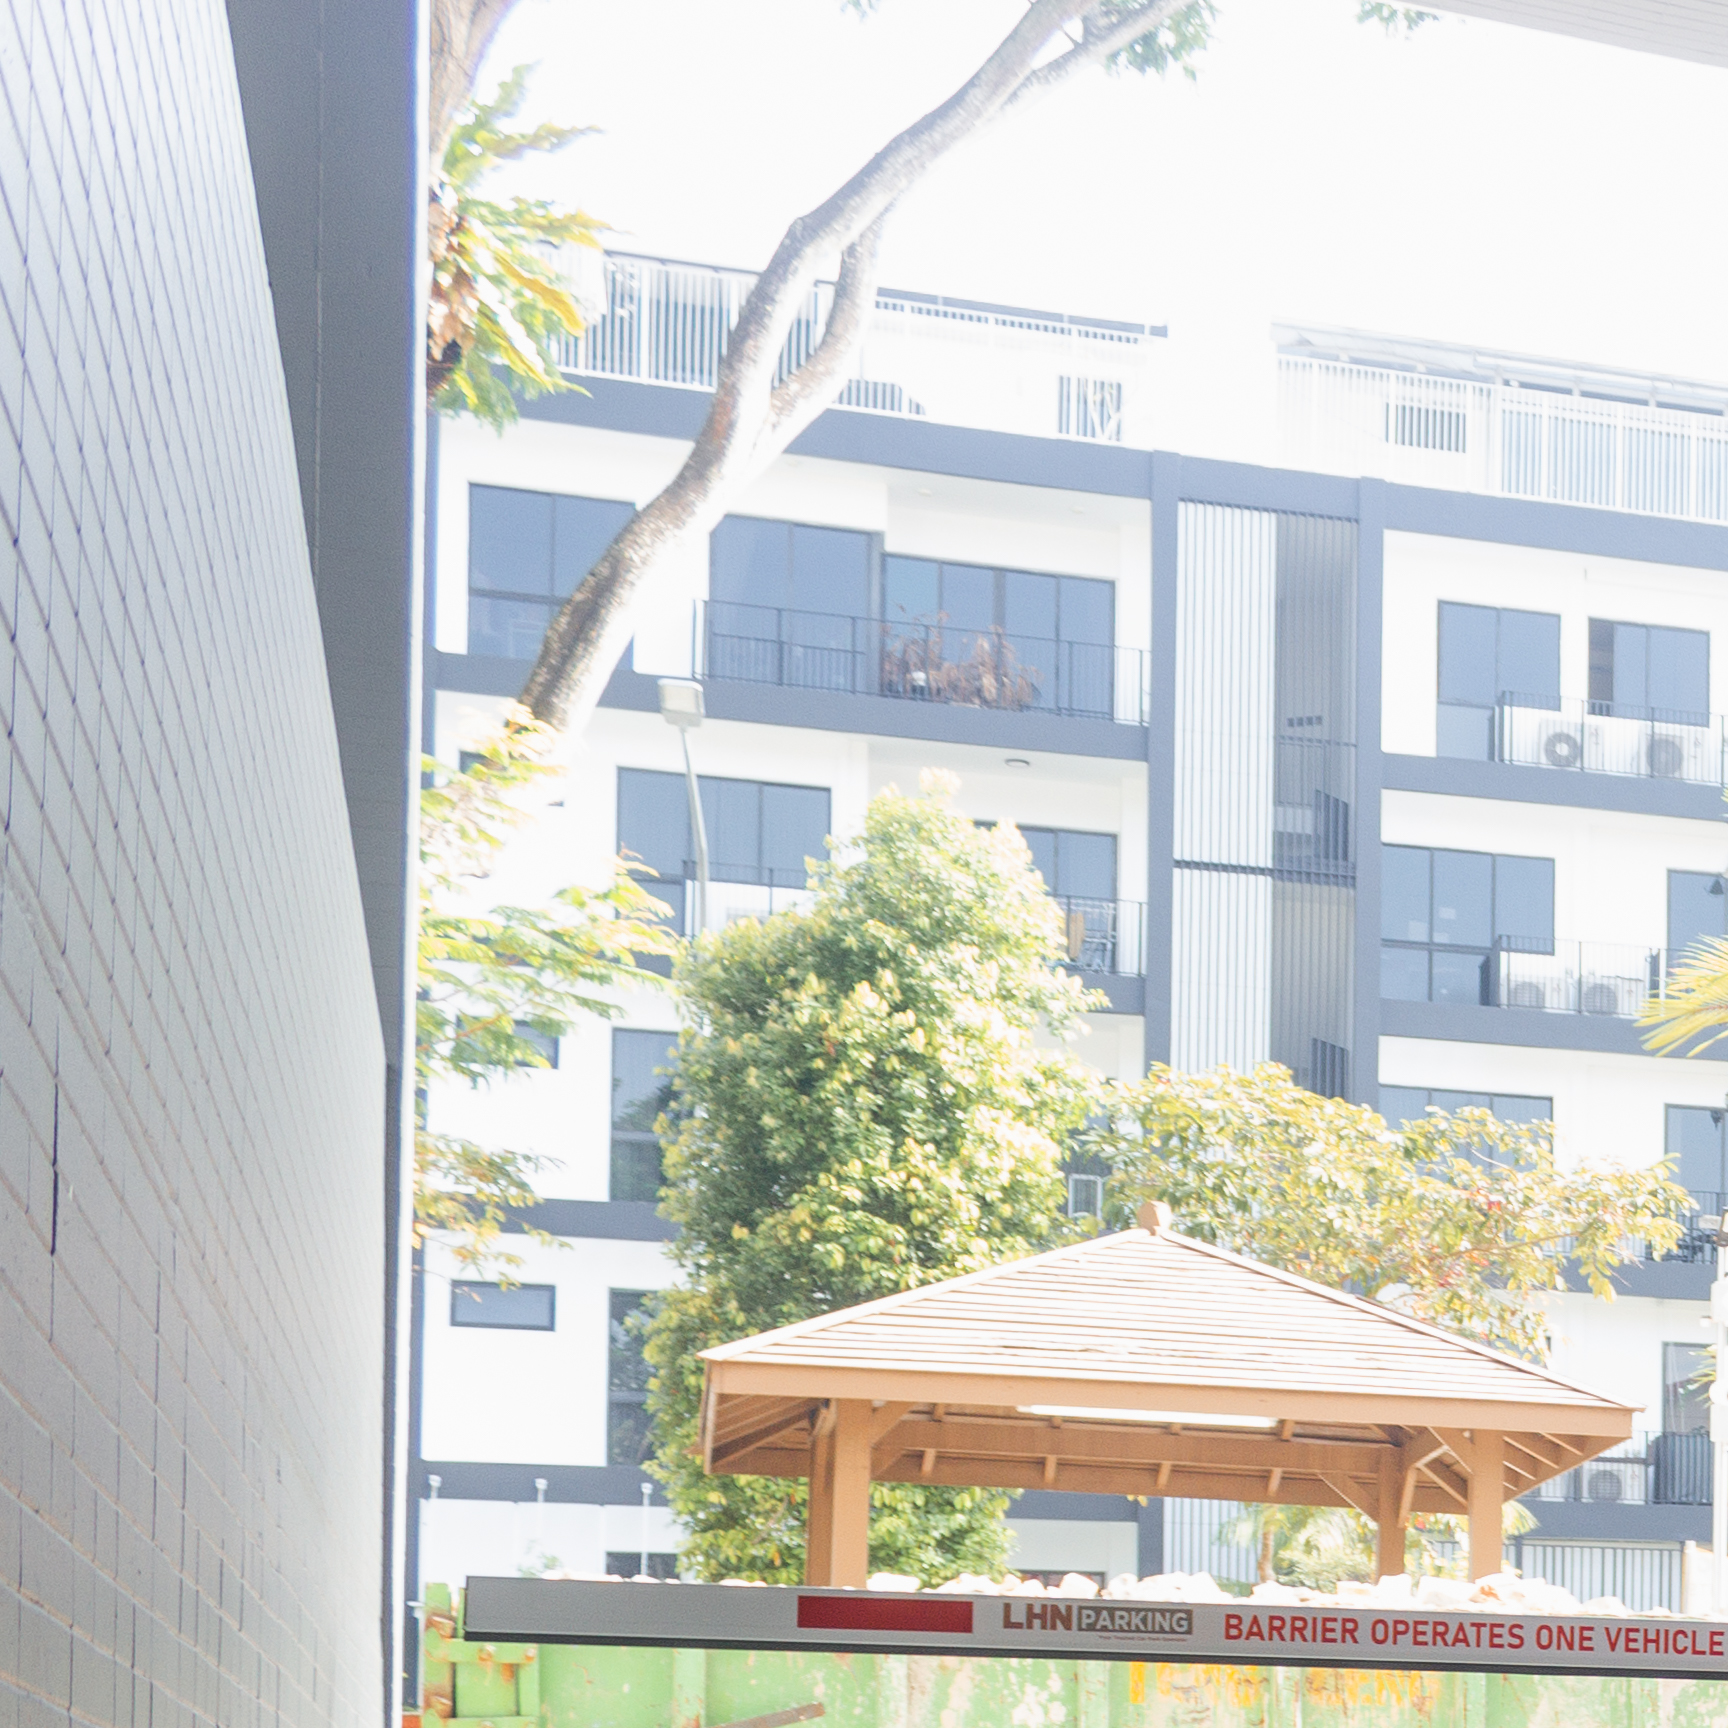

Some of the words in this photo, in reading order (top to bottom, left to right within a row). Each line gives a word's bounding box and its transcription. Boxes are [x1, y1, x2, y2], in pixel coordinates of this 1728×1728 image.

[1003, 1602, 1073, 1631] LHN
[1081, 1608, 1189, 1633] PARKING
[1224, 1612, 1360, 1645] BARRIER
[1370, 1618, 1525, 1650] OPERATES
[1534, 1624, 1596, 1653] ONE
[1603, 1626, 1725, 1657] VEHICLE
